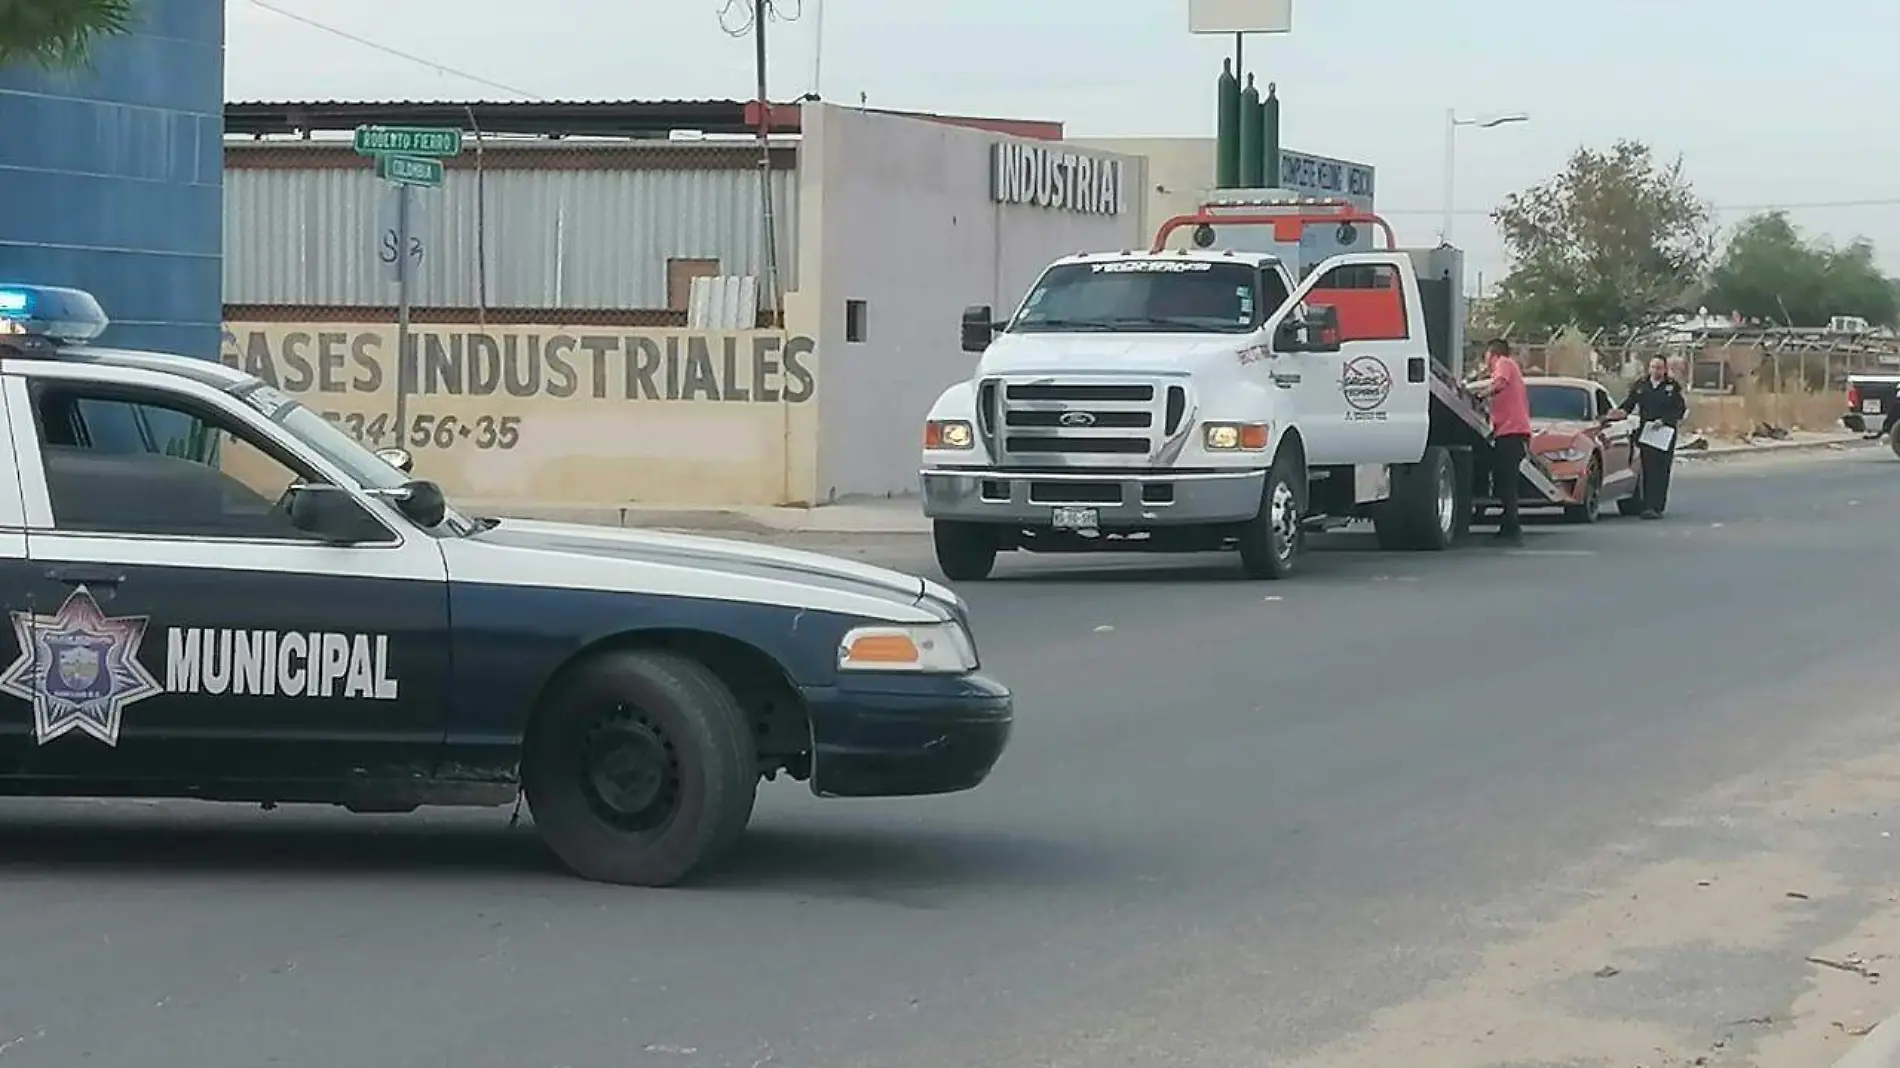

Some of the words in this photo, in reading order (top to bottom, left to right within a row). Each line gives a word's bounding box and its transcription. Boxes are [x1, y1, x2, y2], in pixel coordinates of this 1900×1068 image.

[363, 131, 411, 149] ROBERTO
[413, 133, 451, 151] FIERRO
[992, 142, 1127, 215] INDUSTRIAL
[402, 333, 814, 403] INDUSTRIALES
[166, 627, 398, 699] MUNICIPAL
